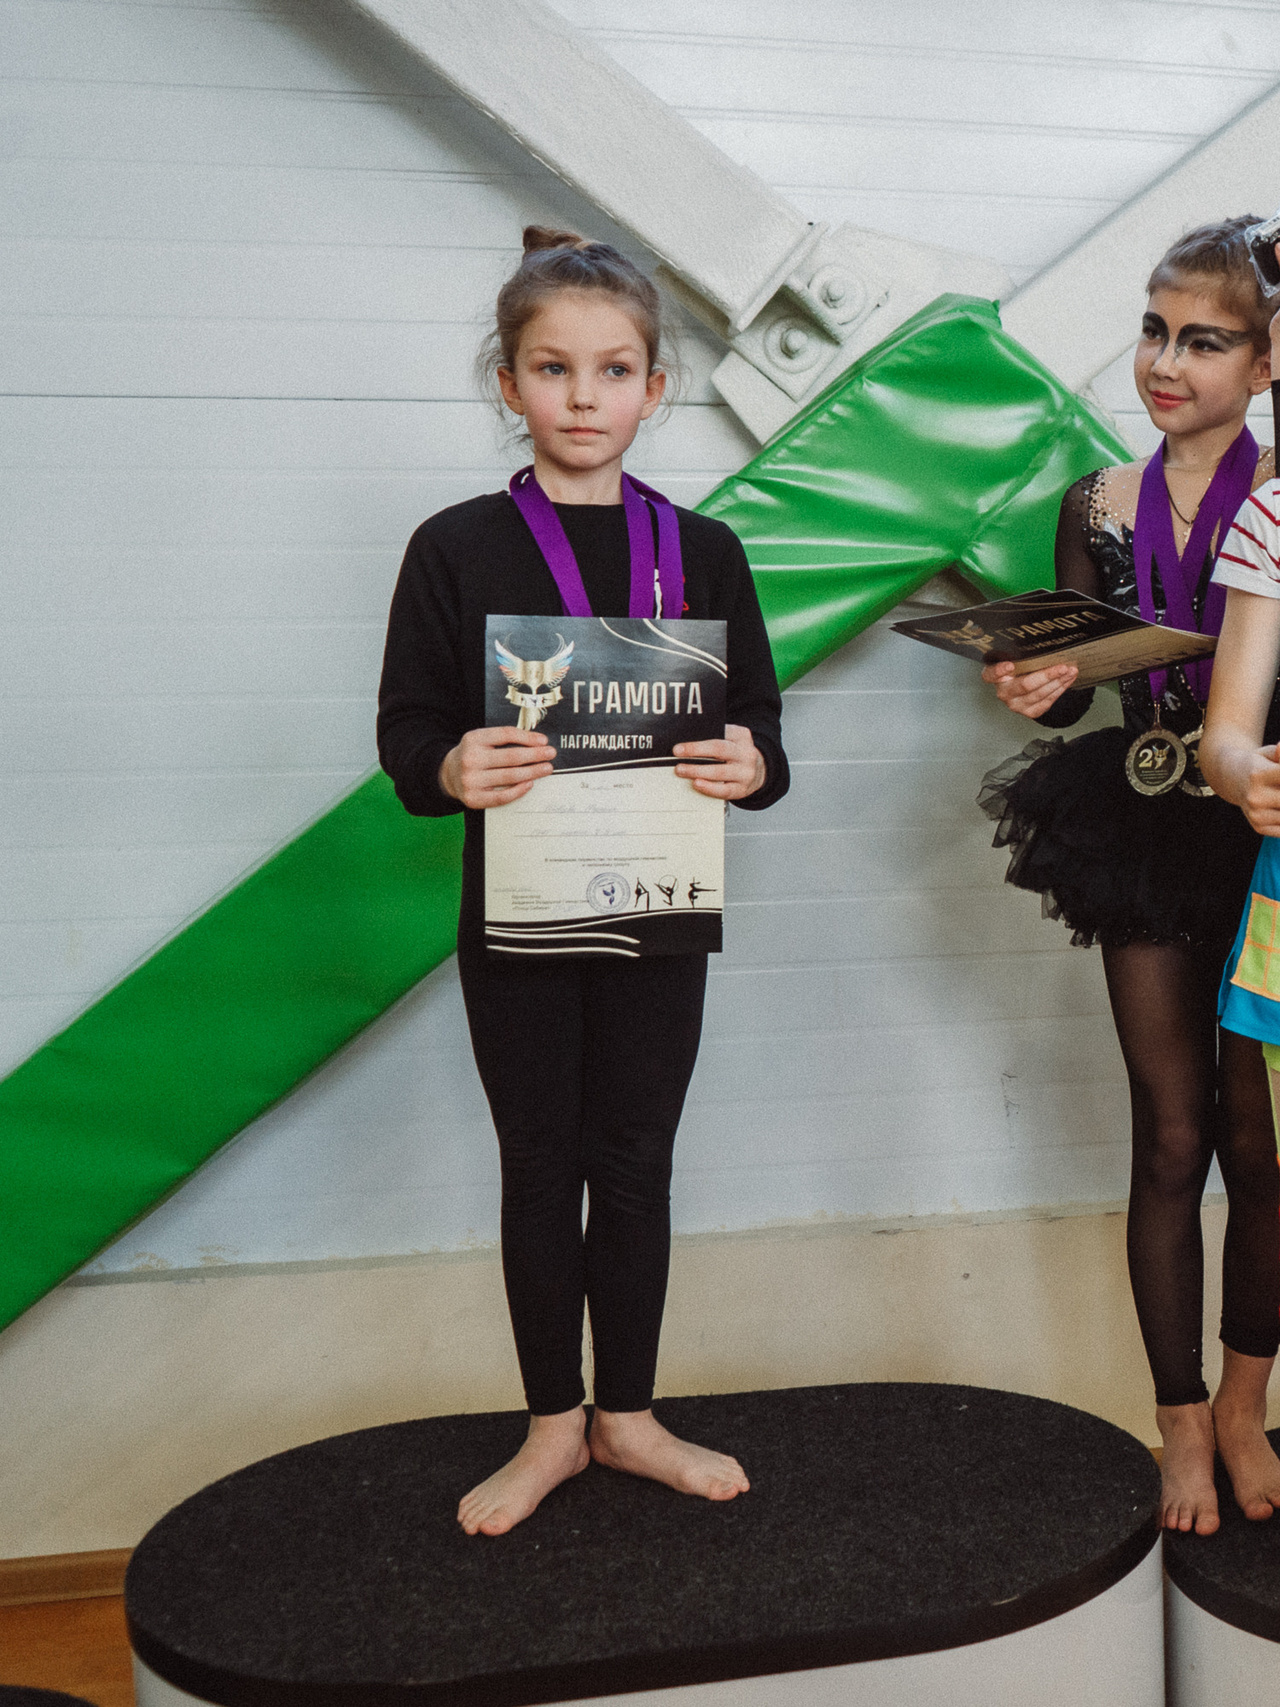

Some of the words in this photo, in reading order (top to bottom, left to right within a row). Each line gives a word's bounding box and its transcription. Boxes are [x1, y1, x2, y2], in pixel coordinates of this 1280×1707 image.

[995, 610, 1107, 641] ГРАМОТА
[572, 680, 703, 715] ГРАМОТА
[560, 733, 653, 750] НАГРАЖДАЕТСЯ
